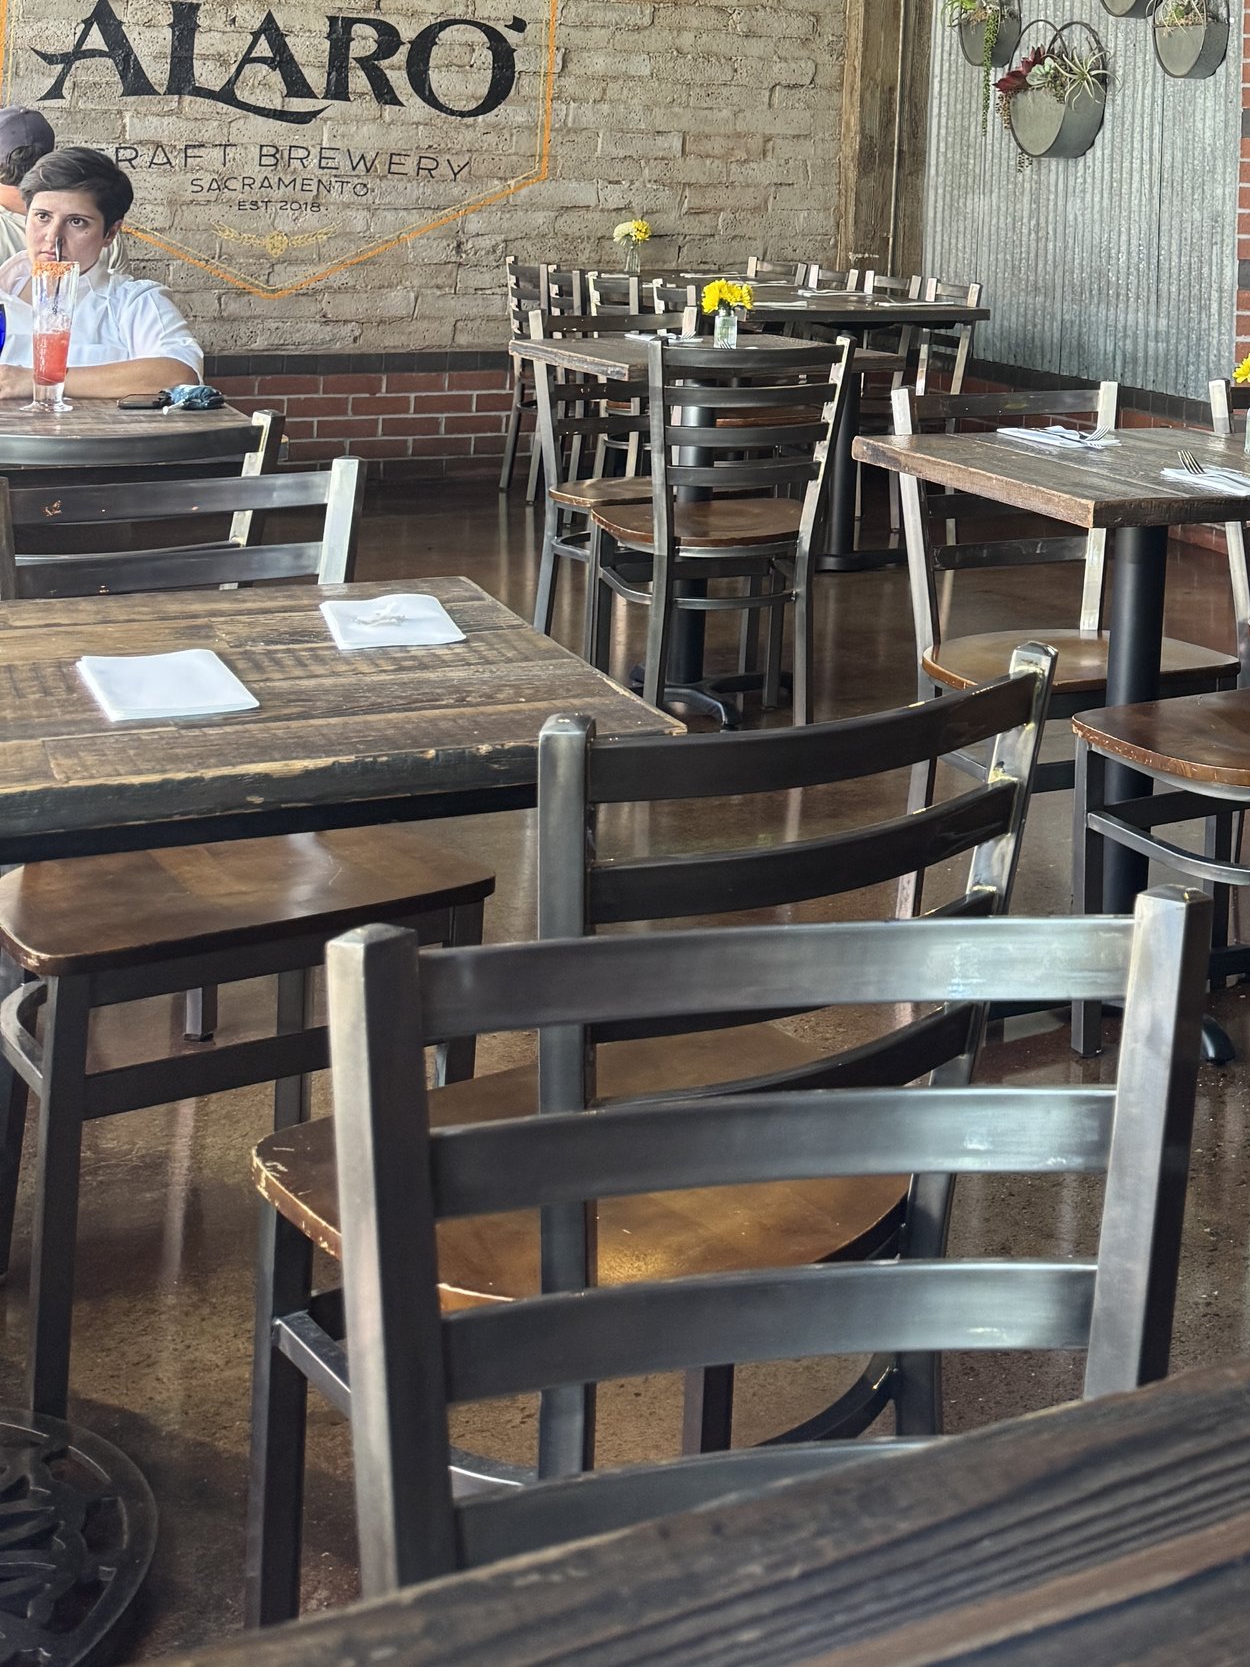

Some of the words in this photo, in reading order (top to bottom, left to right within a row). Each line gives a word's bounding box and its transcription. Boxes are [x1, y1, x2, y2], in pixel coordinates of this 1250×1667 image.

[259, 143, 471, 181] BREWERY
[190, 176, 369, 198] SACRAMENTO
[278, 200, 322, 213] 2018
